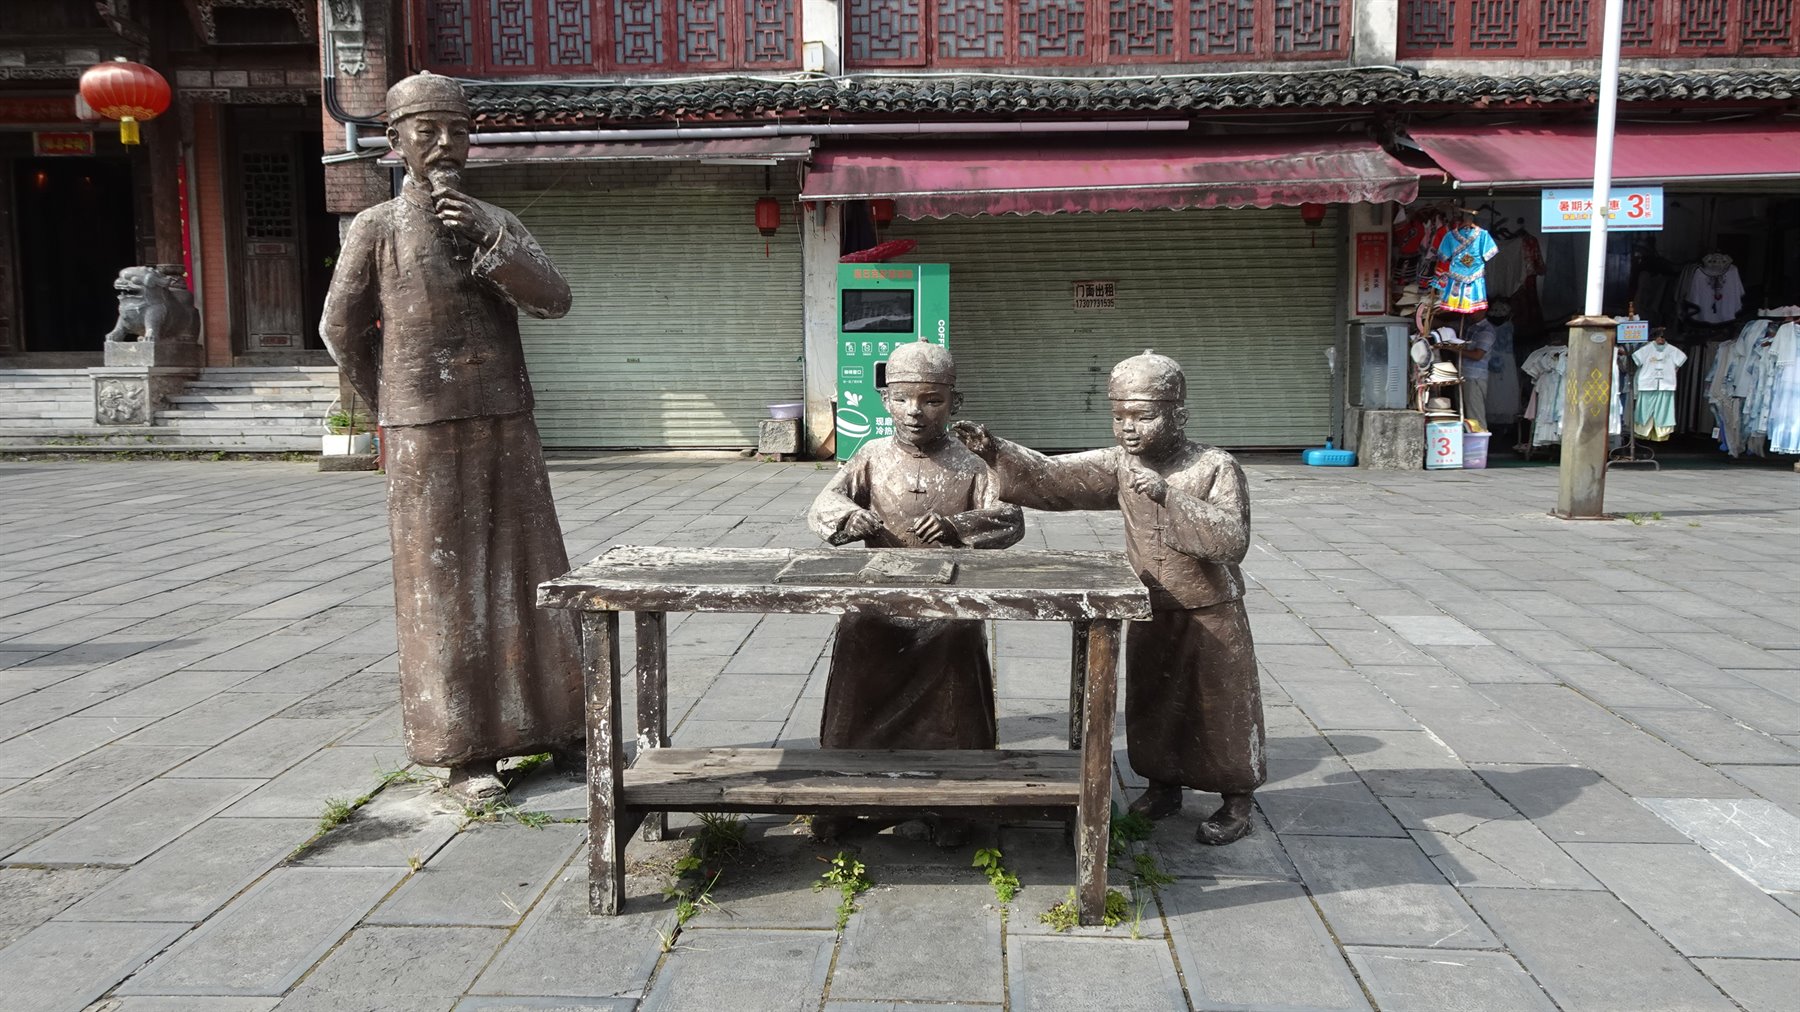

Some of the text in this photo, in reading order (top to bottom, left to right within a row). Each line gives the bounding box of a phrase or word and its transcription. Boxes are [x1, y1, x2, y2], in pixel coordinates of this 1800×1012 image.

[1559, 200, 1619, 211] 暑期大惠
[1627, 194, 1644, 218] 3
[1076, 284, 1114, 297] 门面出租
[876, 417, 893, 426] 现磨
[1437, 437, 1451, 456] 3
